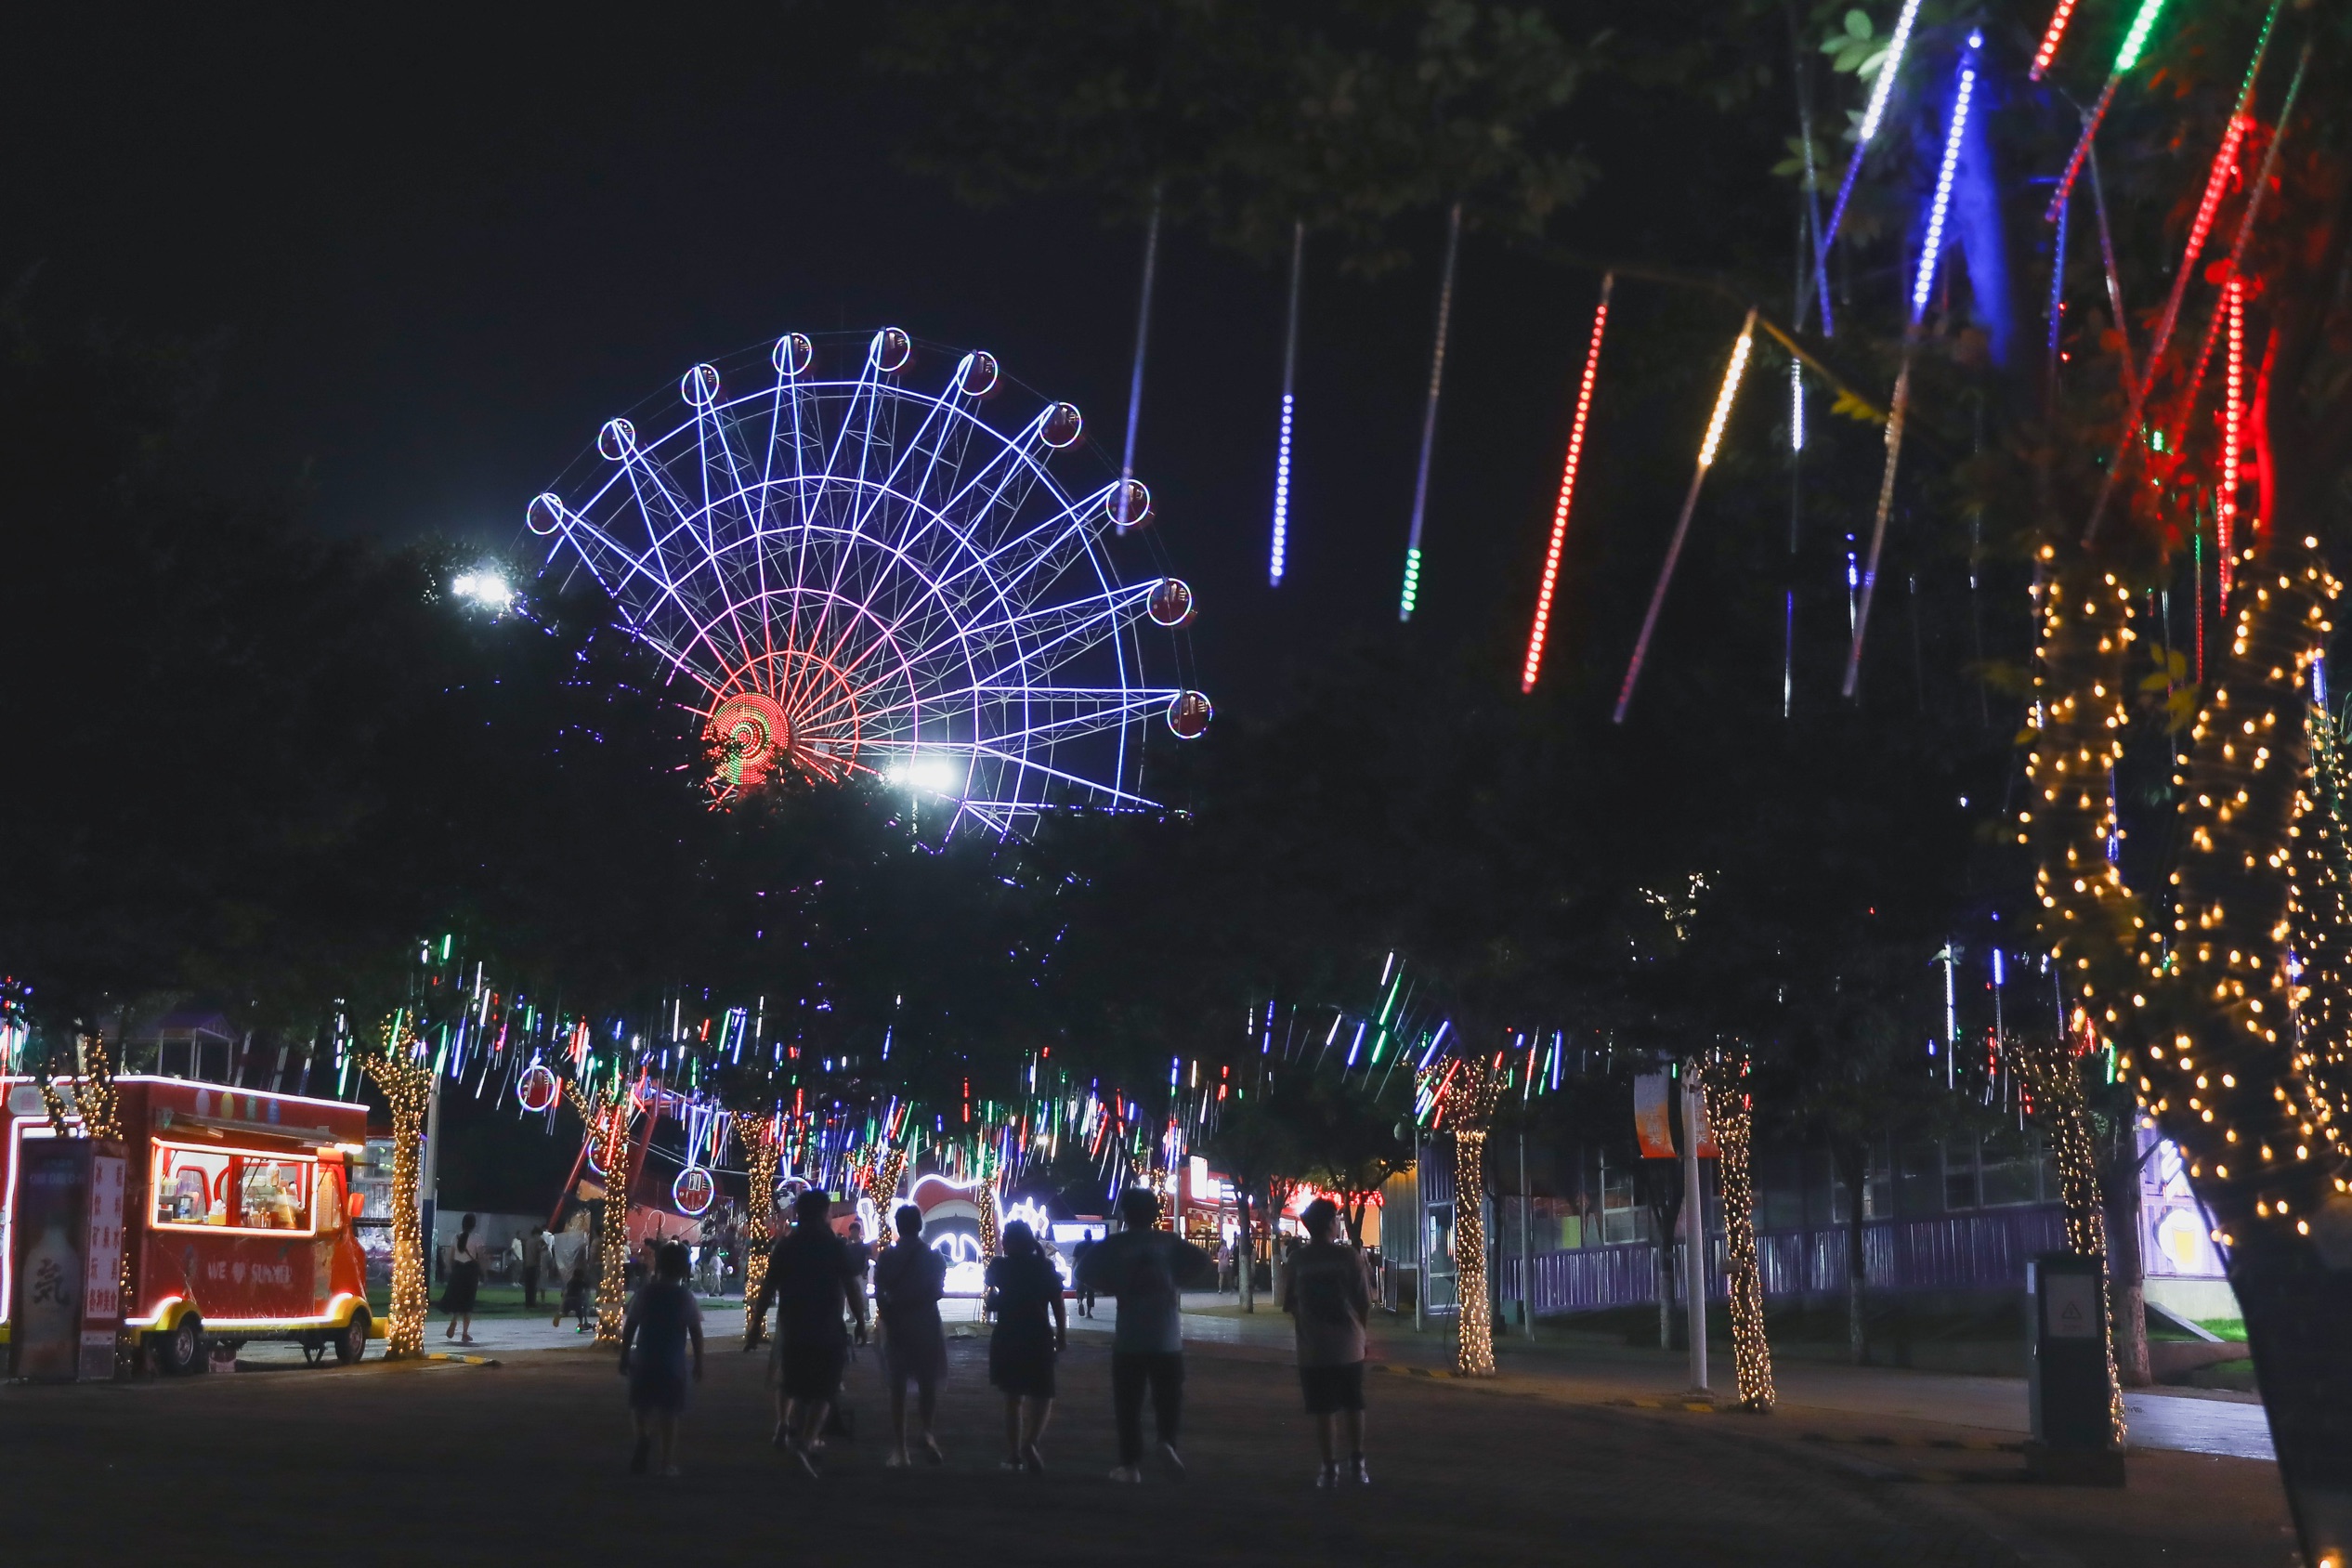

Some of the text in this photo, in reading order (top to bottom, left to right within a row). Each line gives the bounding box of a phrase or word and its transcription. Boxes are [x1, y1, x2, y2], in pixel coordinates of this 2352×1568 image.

[207, 1261, 227, 1279] WE
[89, 1288, 117, 1313] 各种美食
